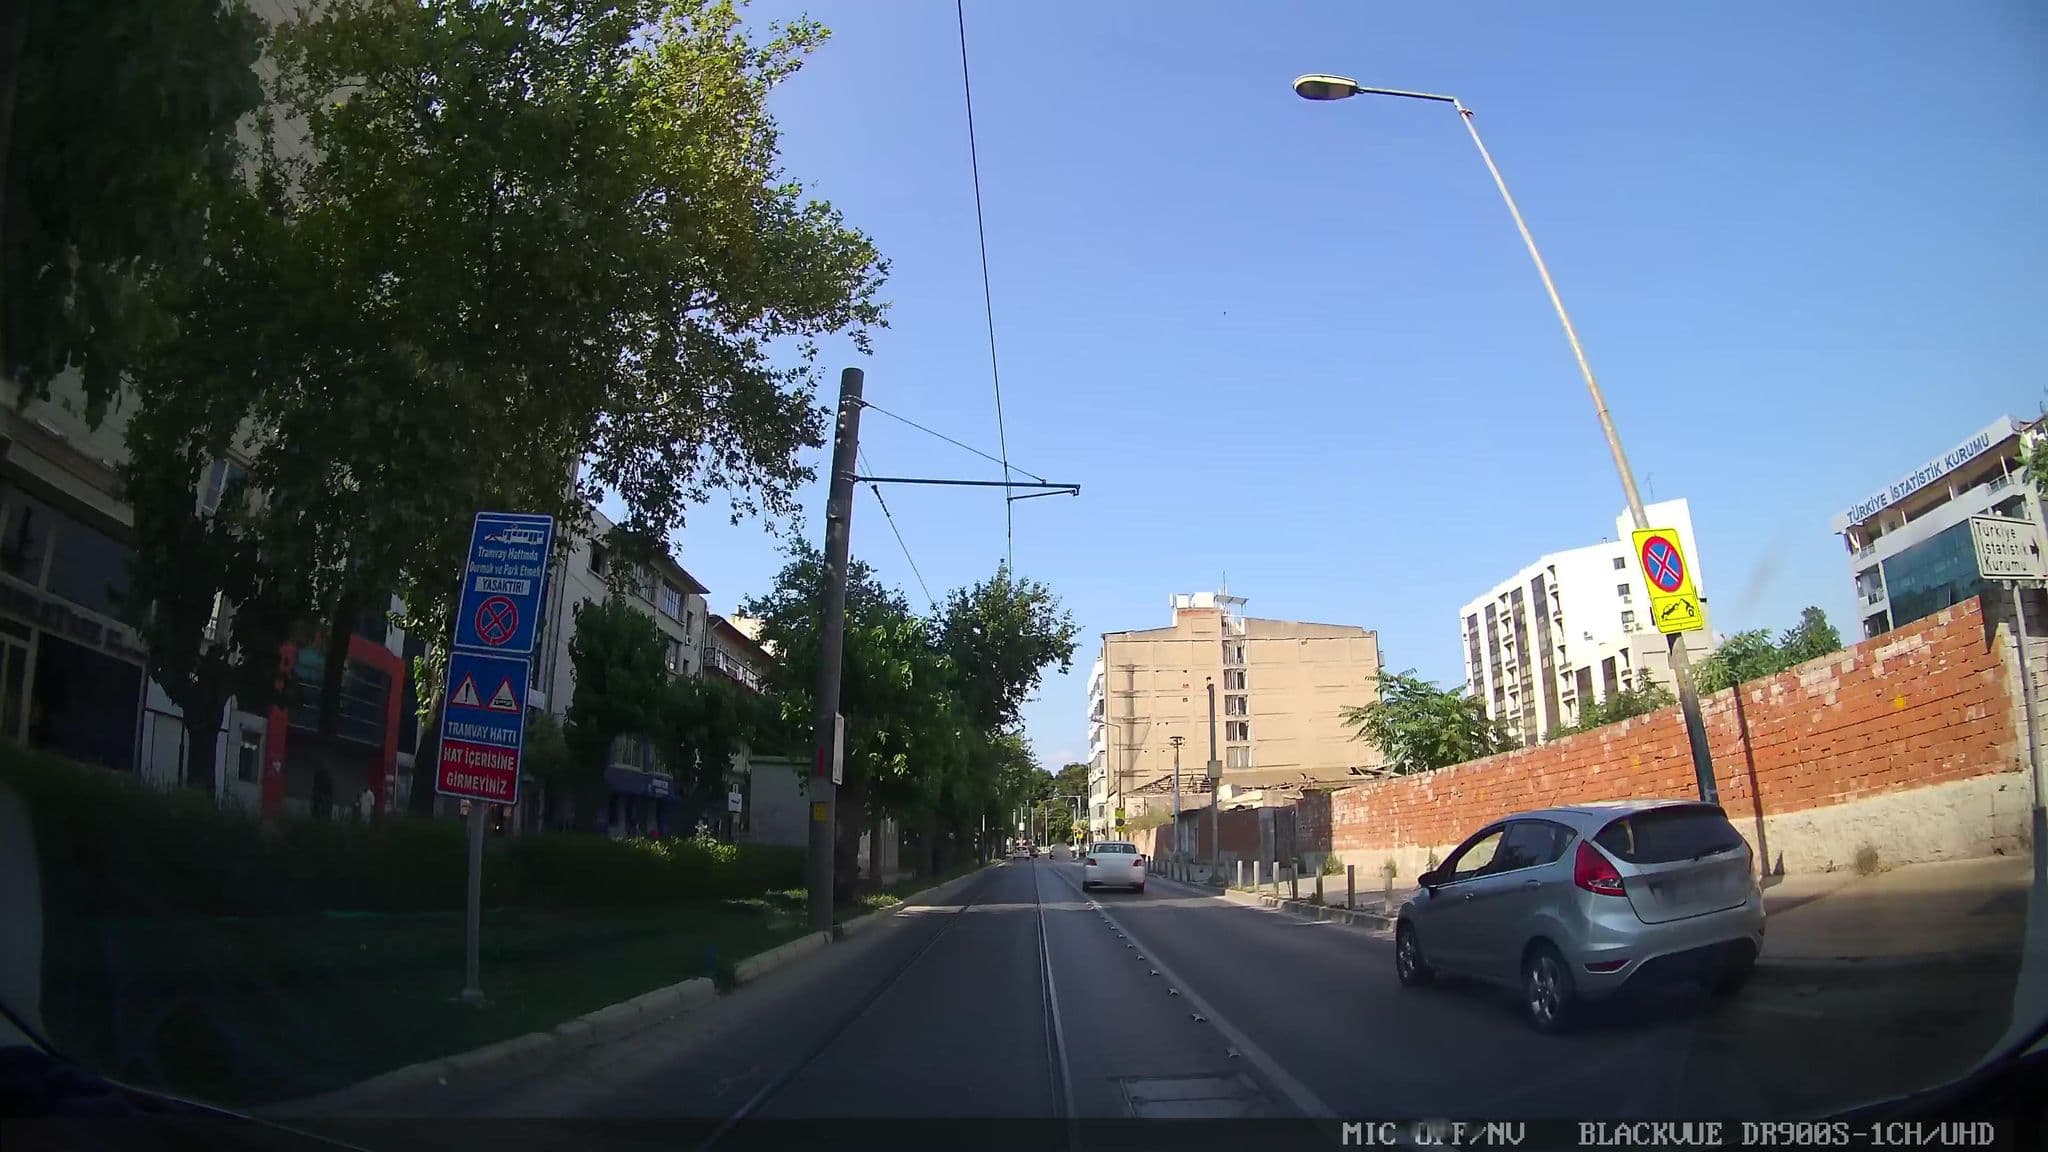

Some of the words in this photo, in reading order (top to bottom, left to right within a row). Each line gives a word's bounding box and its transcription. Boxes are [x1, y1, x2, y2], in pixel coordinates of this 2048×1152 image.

[1846, 492, 1888, 524] TÜRKİYE
[1890, 461, 1943, 501] İSTATİSTİK
[1944, 433, 1990, 470] KURUMU
[478, 545, 506, 562] Tramvay
[1984, 555, 2028, 571] Kurumu
[503, 564, 519, 576] Park
[520, 565, 541, 578] Etmek
[448, 721, 489, 739] TRAMVAY
[490, 727, 517, 743] HATTI
[443, 747, 464, 763] HAT
[465, 747, 515, 771] İÇERİSİNE
[446, 770, 507, 795] GİRMEYİNİZ
